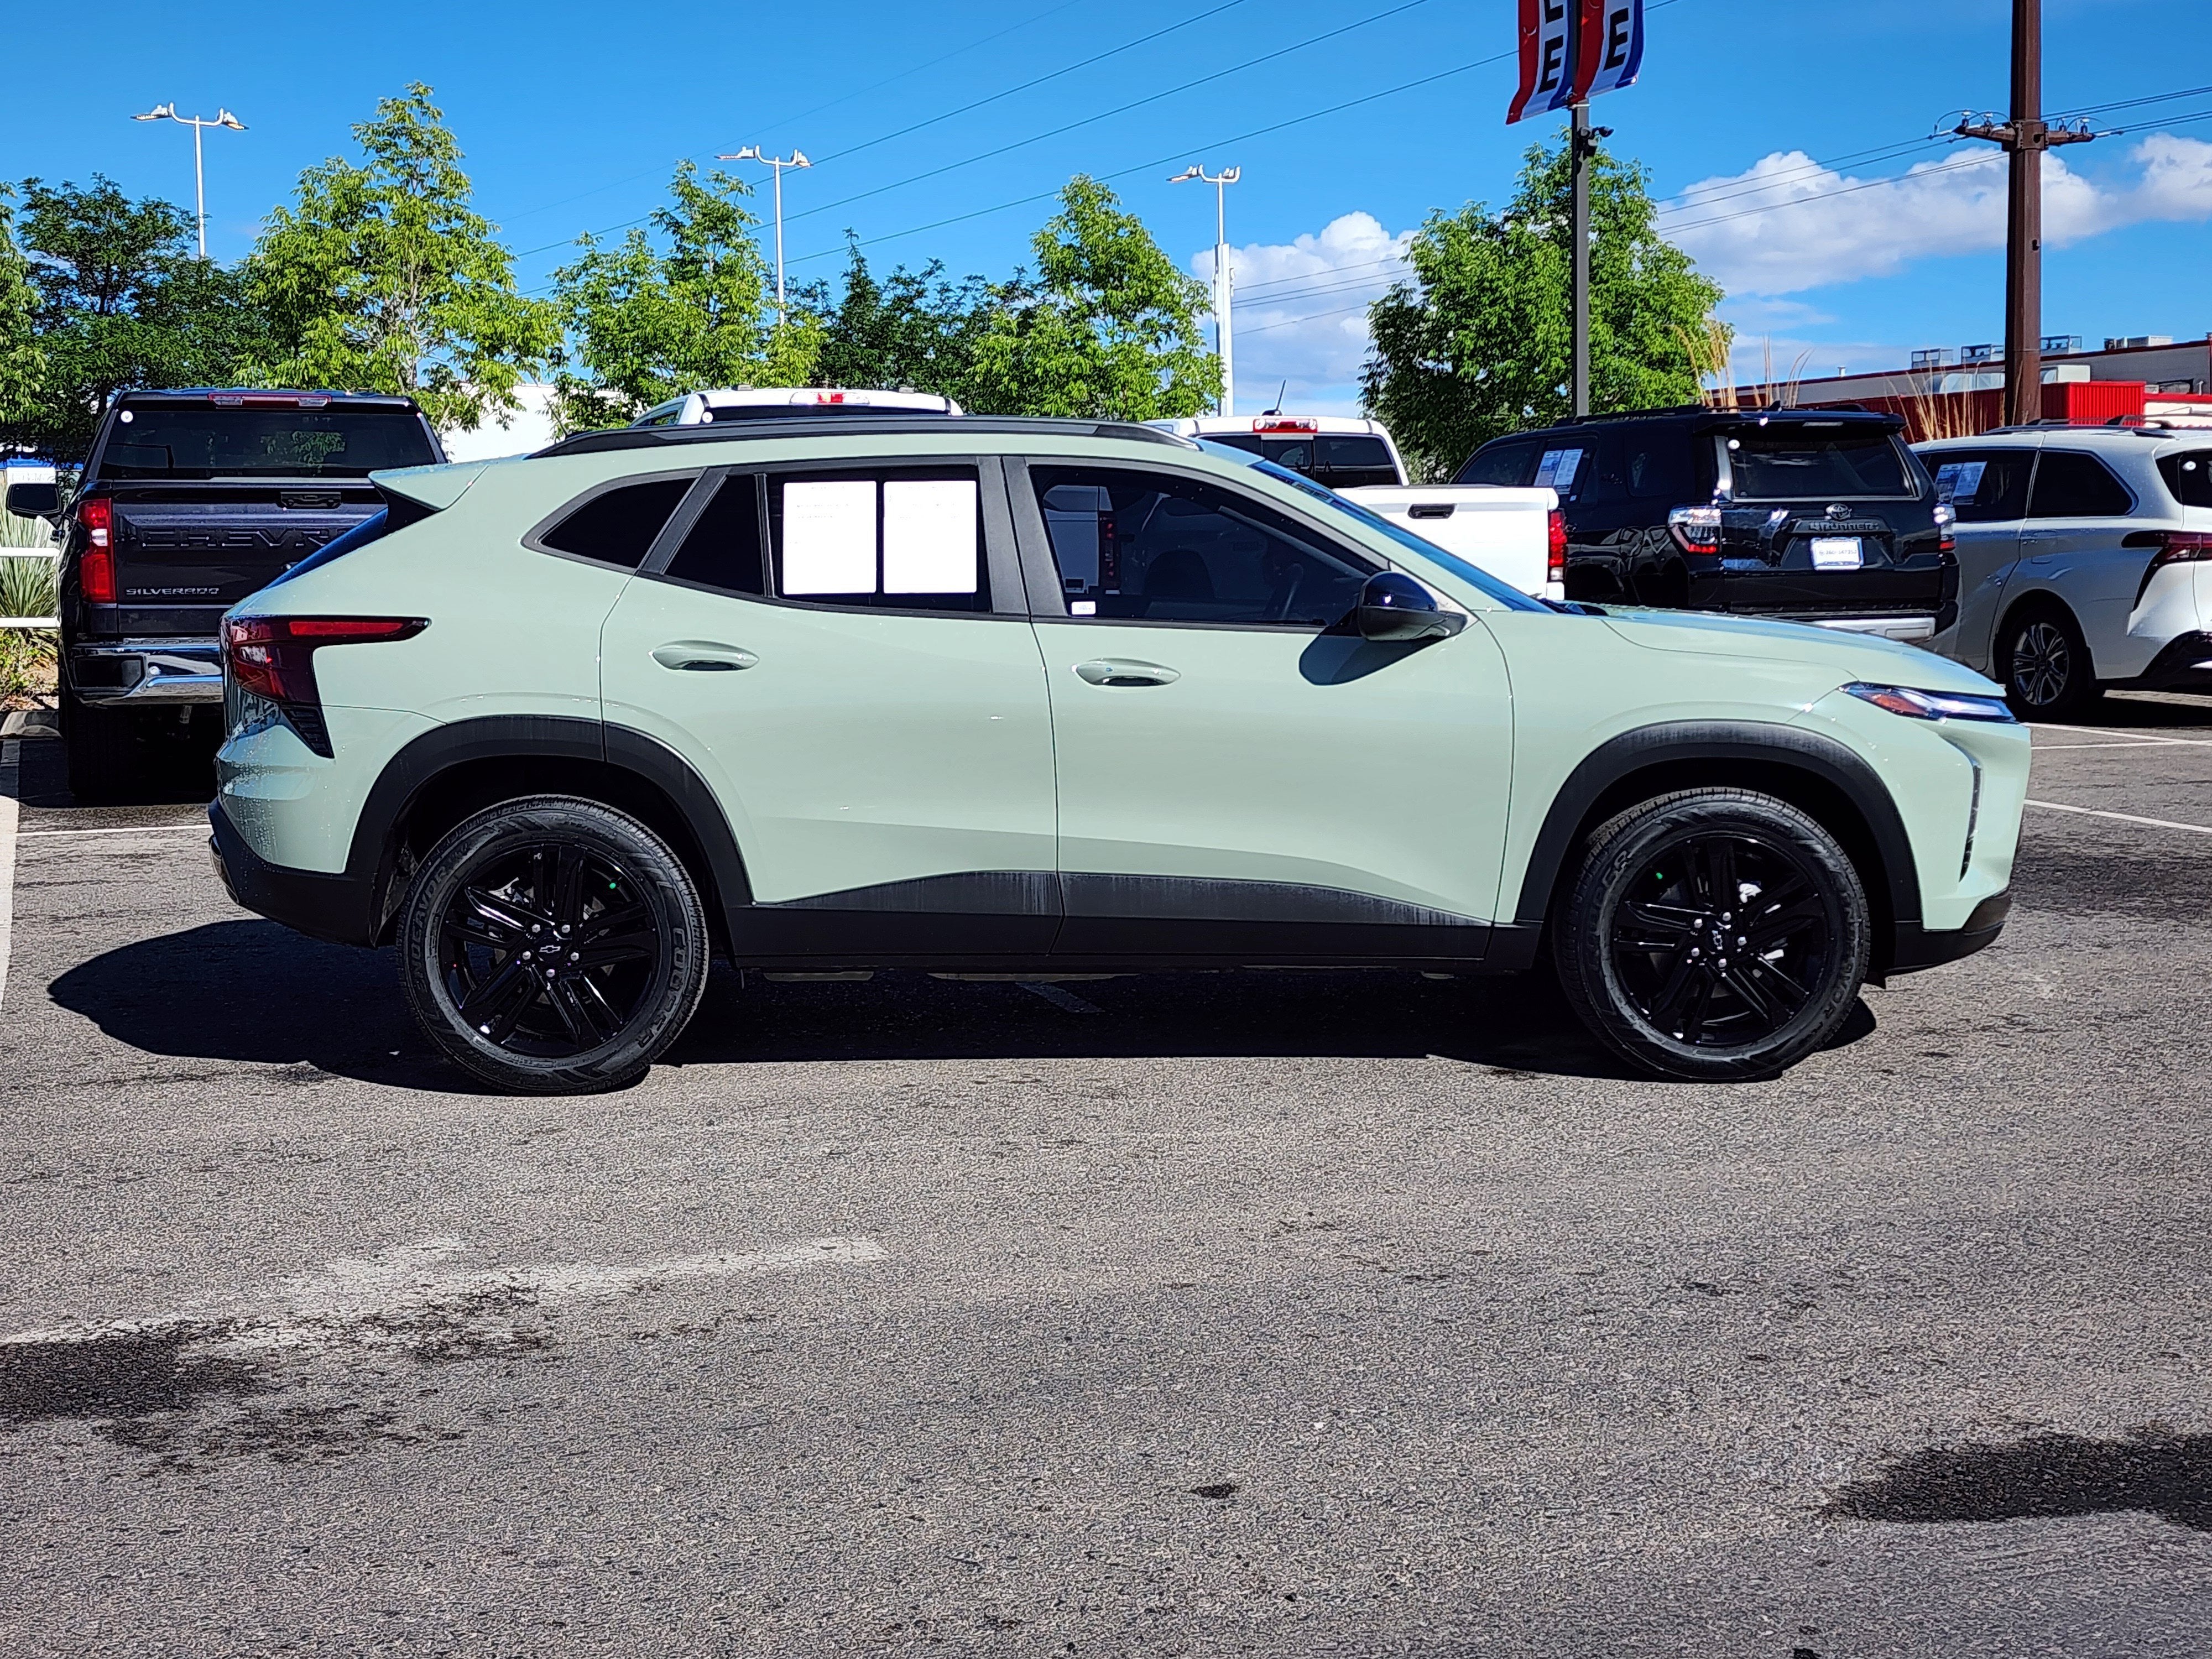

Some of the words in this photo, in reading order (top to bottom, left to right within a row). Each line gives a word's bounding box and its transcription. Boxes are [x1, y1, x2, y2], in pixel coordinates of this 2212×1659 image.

[1603, 7, 1629, 71] E
[142, 528, 342, 547] CHEVR
[1810, 521, 1879, 530] 4RUNNER
[126, 587, 220, 596] SILVERADO
[410, 864, 448, 992] ENDEAVOR
[635, 926, 686, 1048] COOPER
